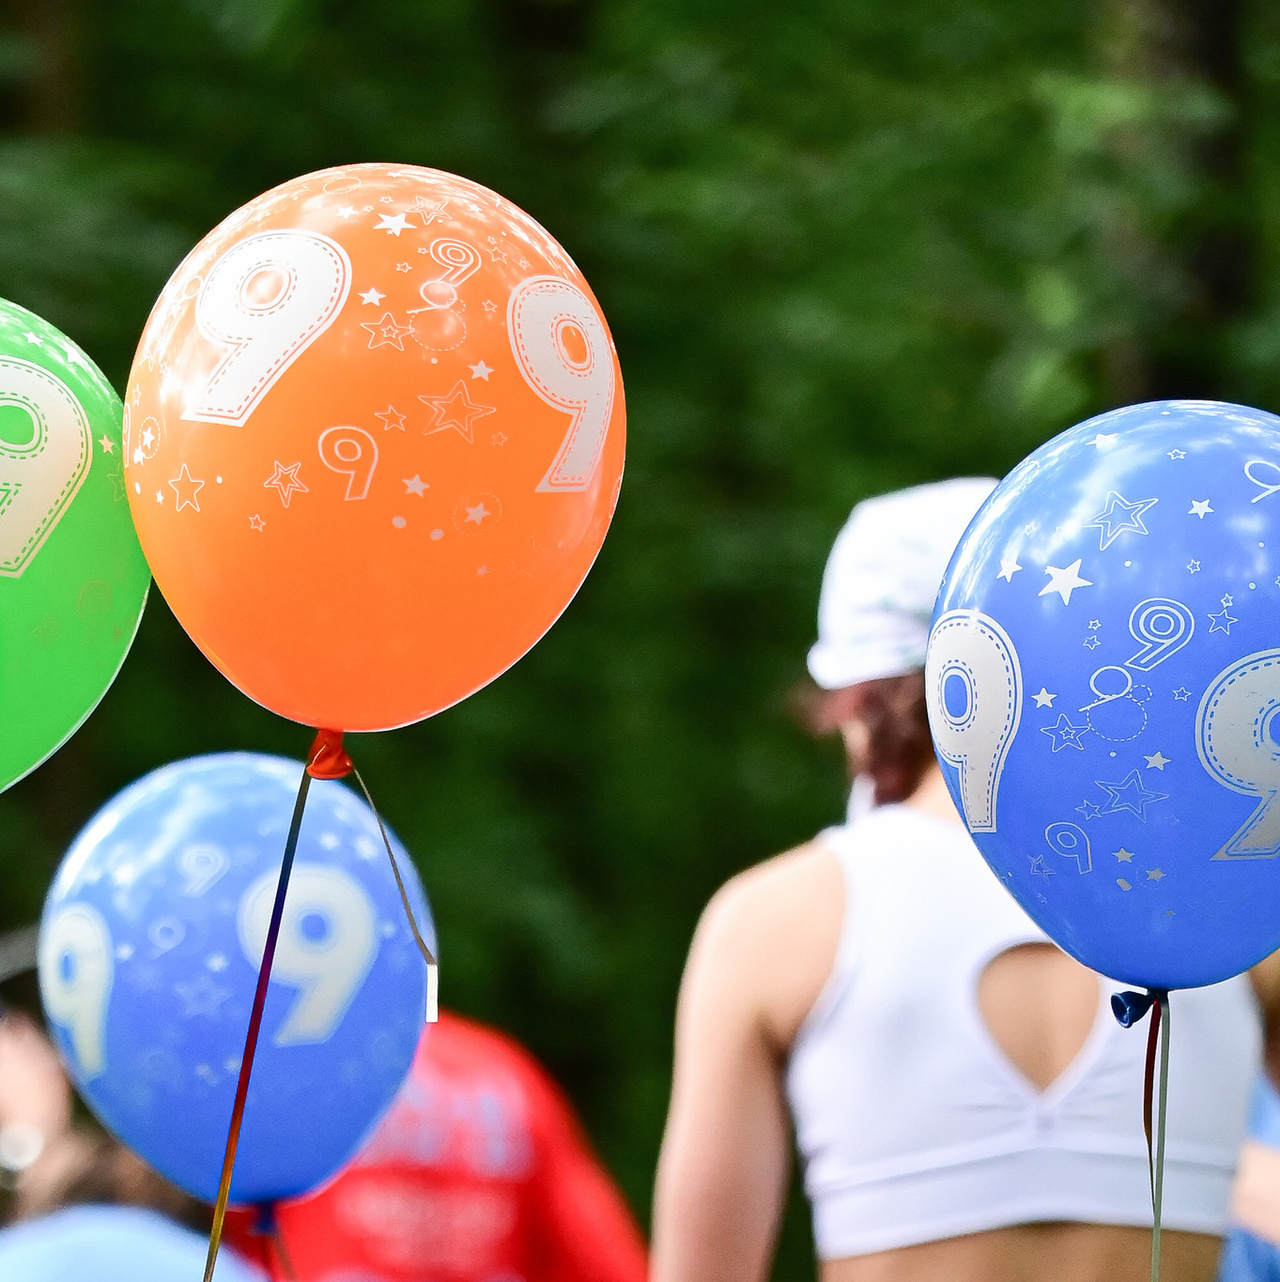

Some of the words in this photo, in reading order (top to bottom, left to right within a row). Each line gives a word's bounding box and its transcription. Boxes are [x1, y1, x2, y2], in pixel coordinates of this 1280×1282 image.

[180, 229, 353, 428] 9
[430, 238, 482, 286] 9
[317, 425, 379, 501] 9
[506, 274, 615, 494] 9
[926, 608, 1023, 834] 9
[1125, 597, 1196, 672] 9
[1044, 821, 1092, 874] 9
[40, 902, 114, 1085] 9
[237, 862, 379, 1048] 9
